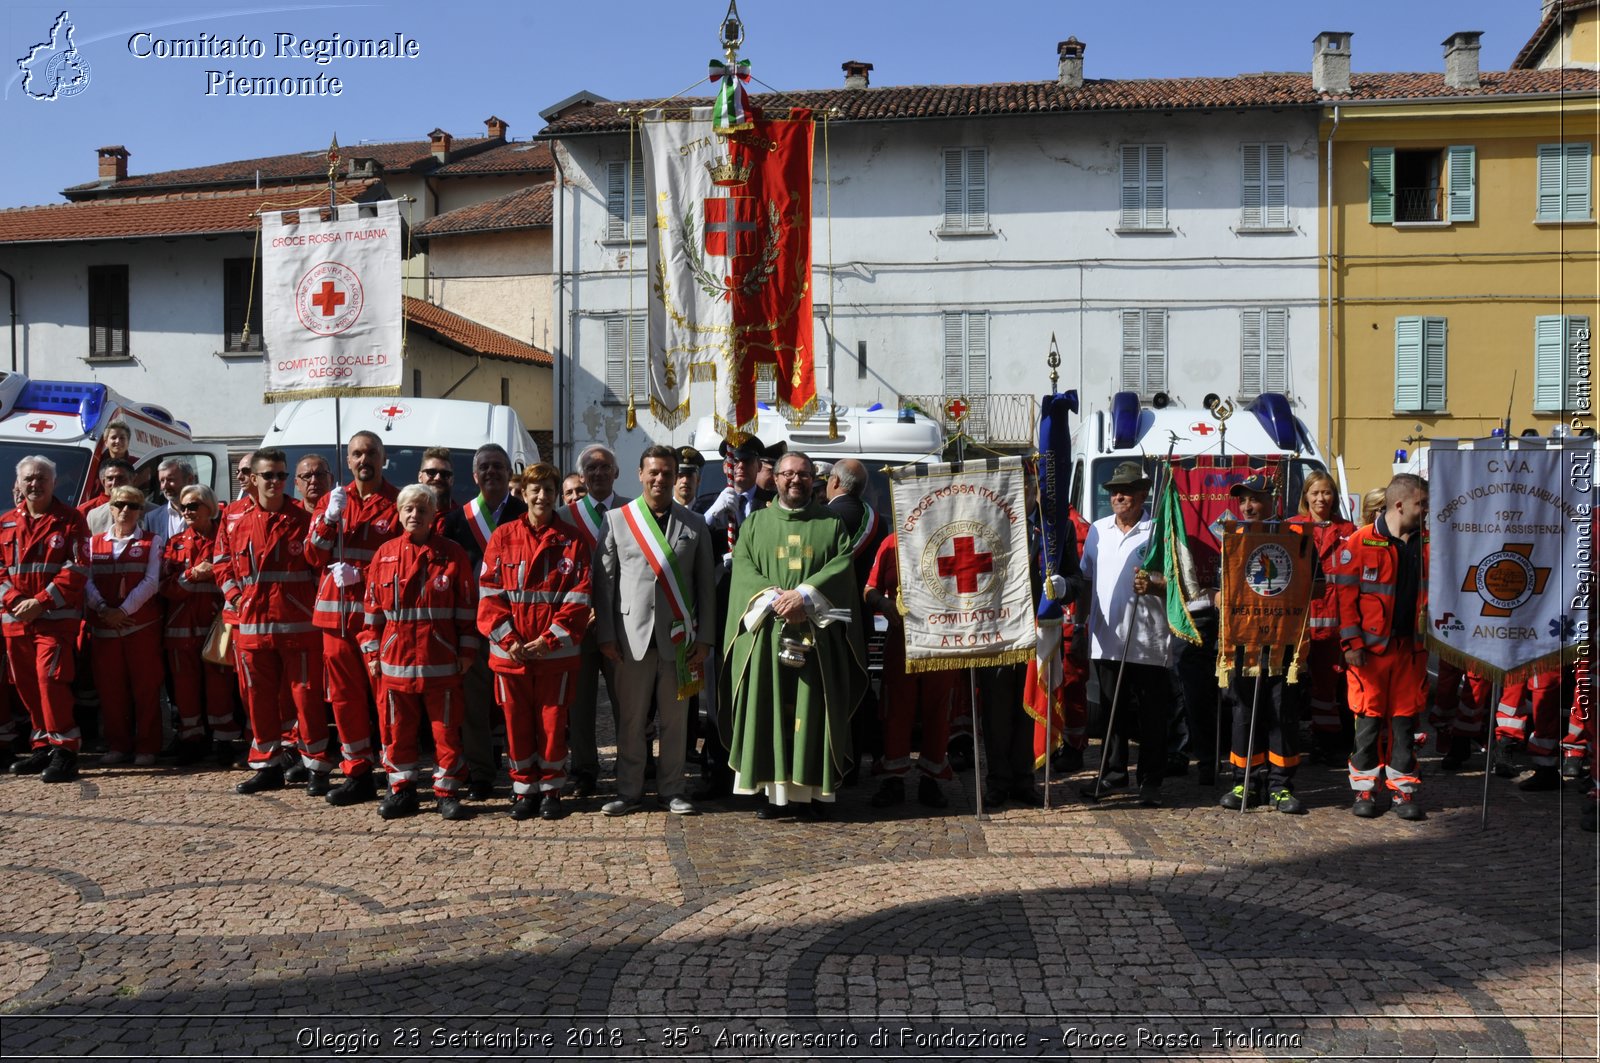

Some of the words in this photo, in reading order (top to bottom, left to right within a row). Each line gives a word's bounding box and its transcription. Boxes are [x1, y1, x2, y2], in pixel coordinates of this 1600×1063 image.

[272, 235, 305, 248] CROCE
[309, 232, 341, 244] ROSSA
[345, 228, 387, 242] ITALIANA
[343, 273, 352, 281] 22
[349, 283, 359, 316] AGOSTO
[278, 356, 327, 371] COMITATO
[331, 354, 374, 366] LOCALE
[377, 353, 387, 365] DI
[308, 367, 353, 378] OLEGGIO
[1487, 460, 1534, 473] C.V.A.
[904, 494, 934, 532] CROCE
[935, 484, 975, 501] ROSSA
[978, 487, 1018, 524] ITALIANA
[1437, 495, 1467, 523] CORPO
[1466, 483, 1528, 500] VOLONTARI
[1495, 511, 1523, 521] 1977
[1452, 522, 1501, 533] PUBBLICA
[1504, 523, 1565, 534] ASSISTENZA
[1482, 552, 1517, 567] VOLONTARI
[1516, 556, 1534, 591] AMBULANZA
[1490, 598, 1521, 608] ANGERA
[928, 609, 996, 625] COMITATO
[999, 607, 1011, 619] DI
[1231, 607, 1250, 616] AREA
[1254, 608, 1262, 616] DI
[1264, 607, 1283, 616] BASE
[941, 631, 1004, 647] ARONA
[1472, 625, 1538, 640] ANGERA
